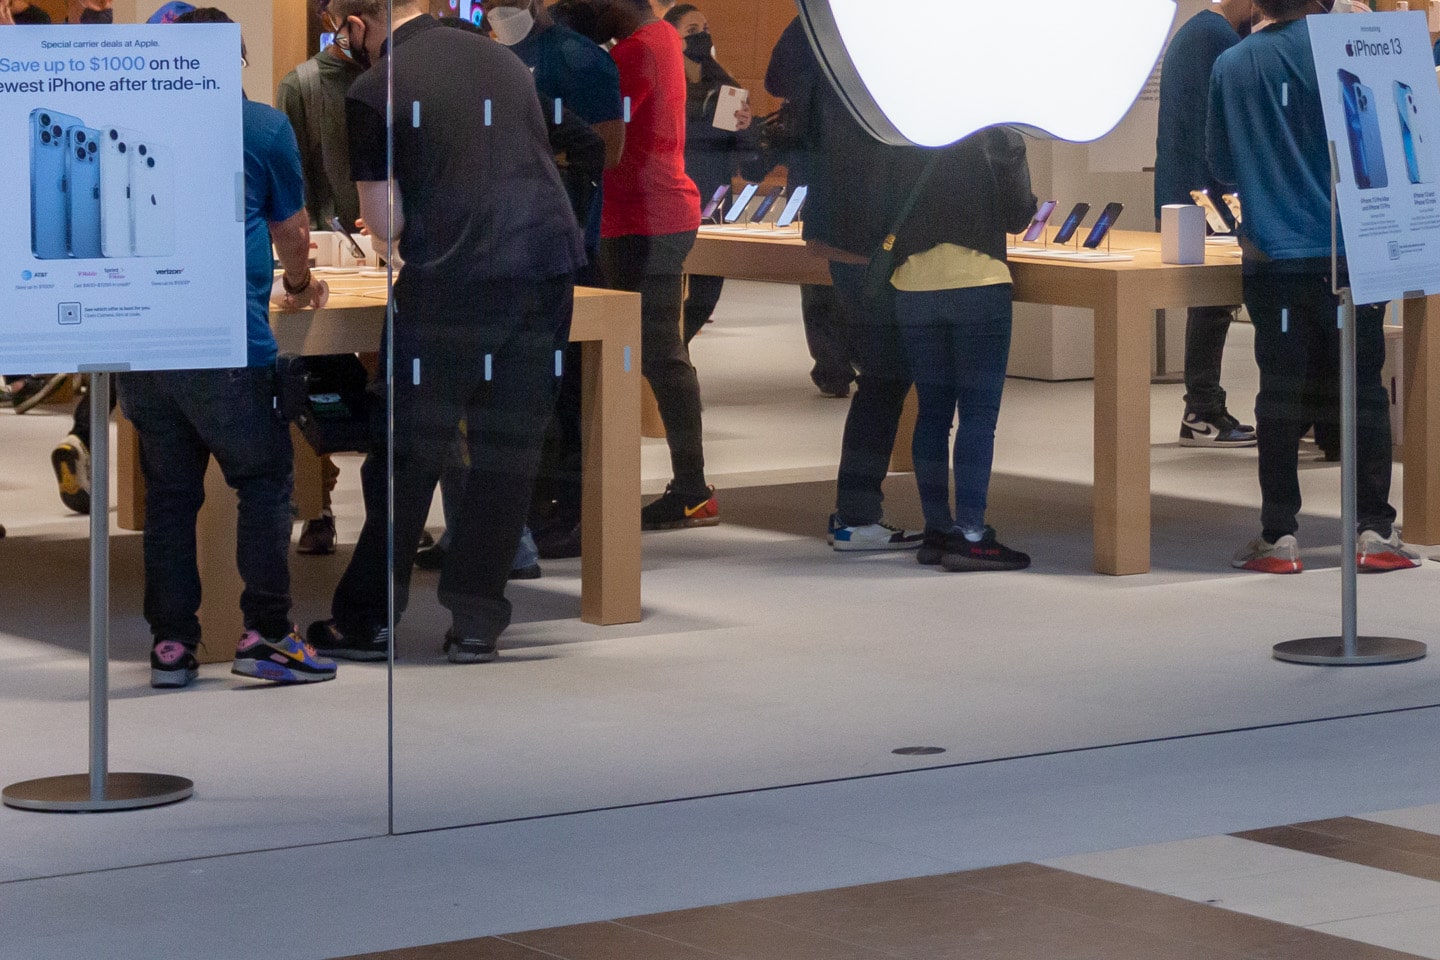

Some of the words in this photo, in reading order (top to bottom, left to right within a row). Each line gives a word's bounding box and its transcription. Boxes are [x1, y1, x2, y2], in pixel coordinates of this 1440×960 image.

[40, 40, 72, 49] Special
[73, 39, 99, 48] carrier
[100, 39, 123, 48] deals
[134, 39, 160, 49] Apple.
[1353, 39, 1390, 57] iPhone
[1390, 37, 1403, 56] 13
[0, 57, 40, 73] Save
[44, 59, 65, 74] up
[69, 57, 85, 72] to
[89, 56, 146, 72] $1000
[149, 58, 170, 71] on
[174, 55, 200, 70] the
[0, 79, 44, 93] west
[48, 77, 105, 92] iPhone
[109, 76, 148, 91] after
[151, 75, 221, 91] trade-in.
